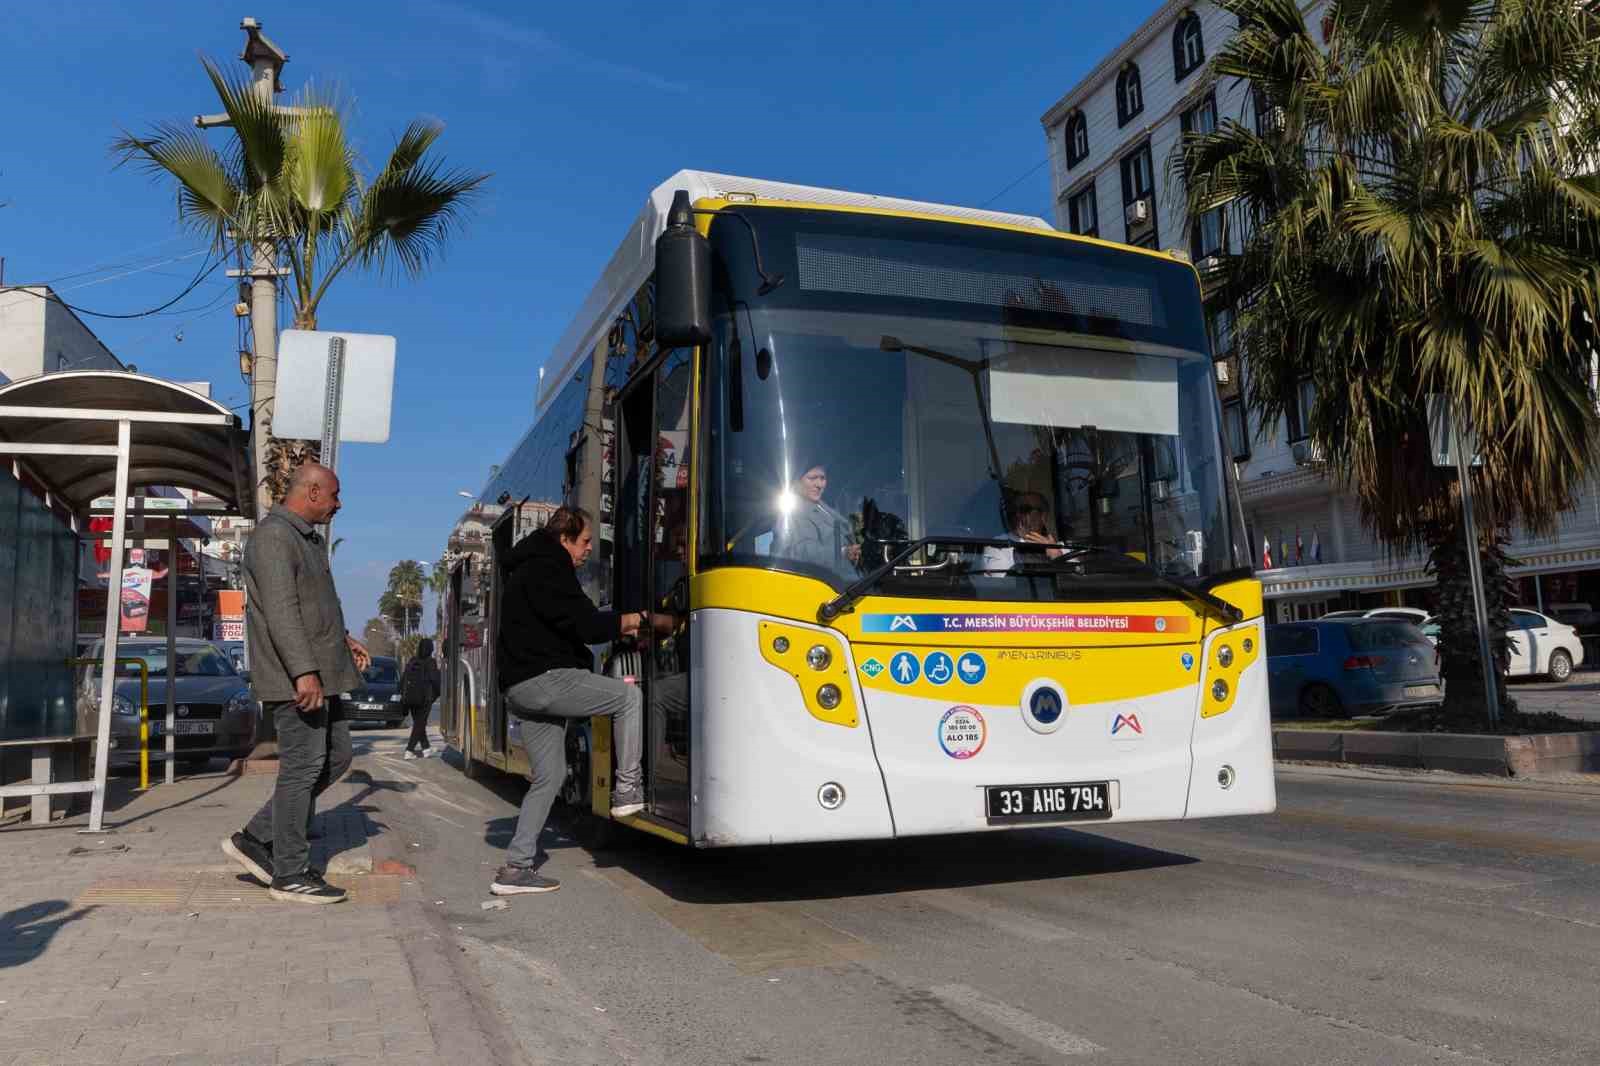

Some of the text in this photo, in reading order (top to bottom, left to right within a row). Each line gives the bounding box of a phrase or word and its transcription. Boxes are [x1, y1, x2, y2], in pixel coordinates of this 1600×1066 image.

[943, 615, 1128, 630] T.C. MERSİN BÜYÜKŞEHİR BELEDİYESİ
[863, 662, 881, 672] CNG
[1000, 786, 1103, 814] 33 AHG 794
